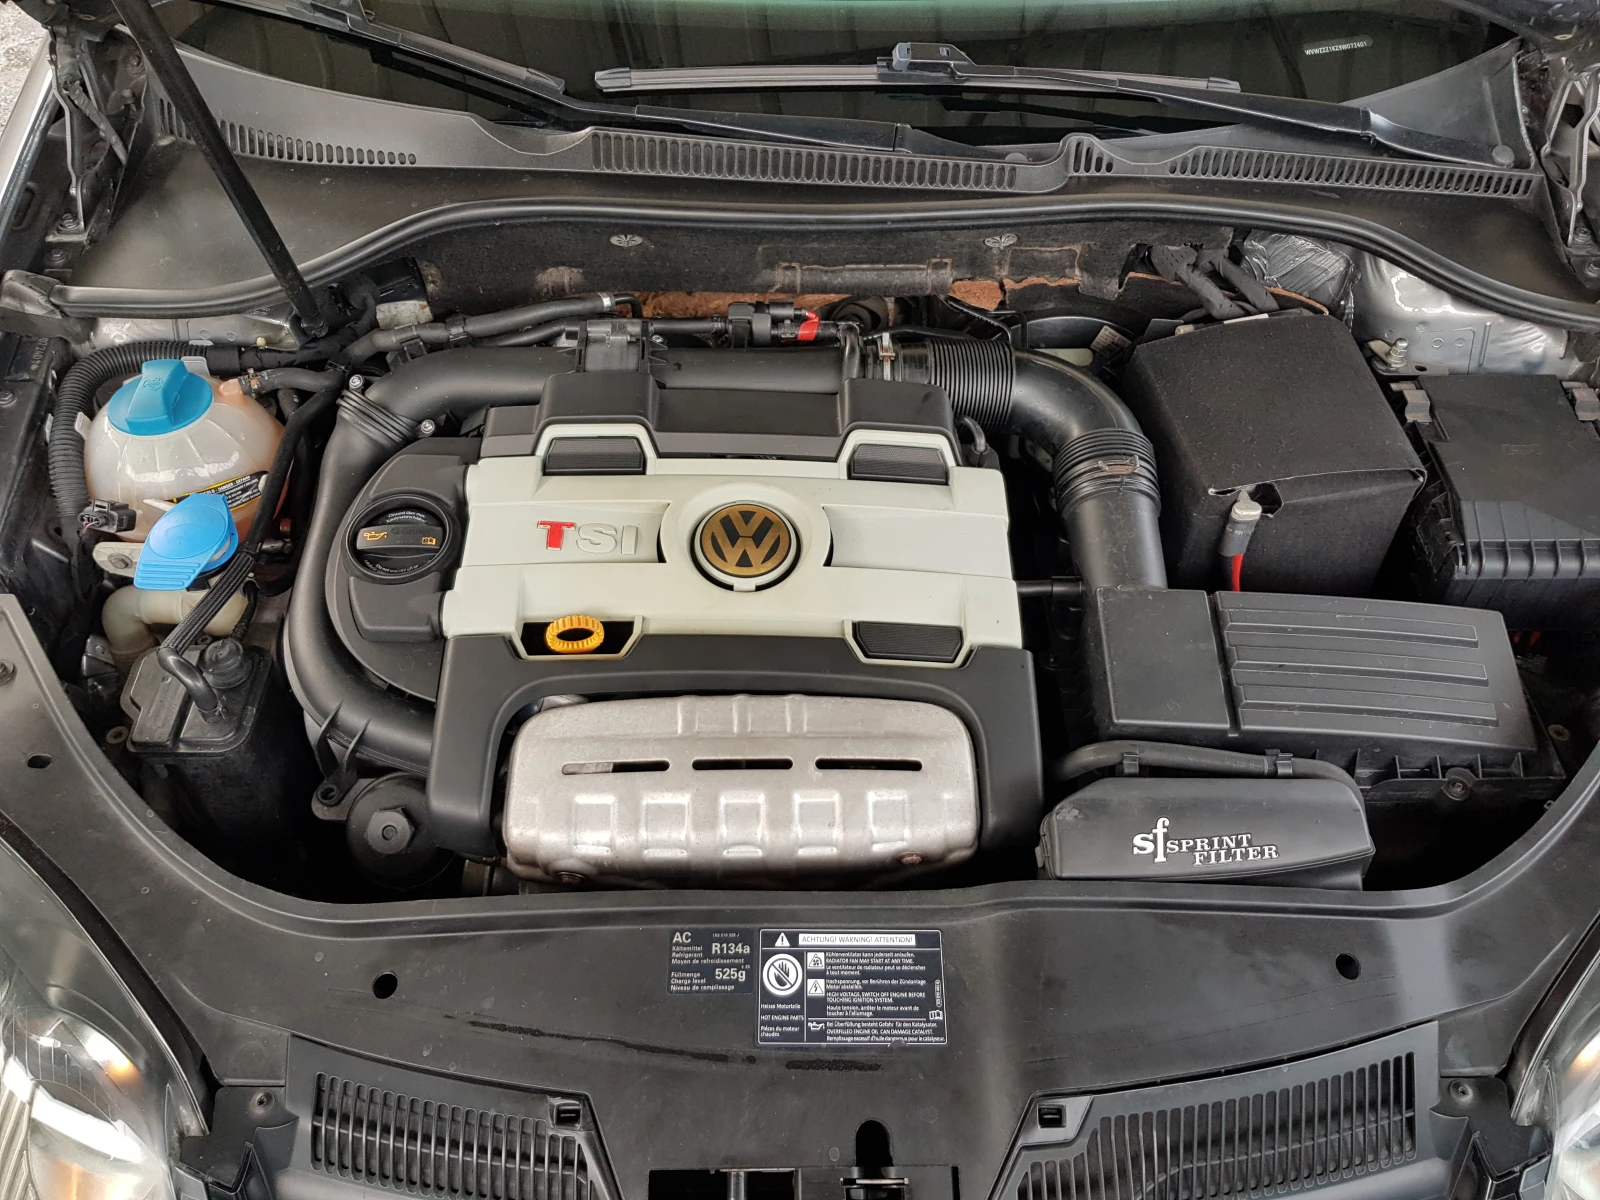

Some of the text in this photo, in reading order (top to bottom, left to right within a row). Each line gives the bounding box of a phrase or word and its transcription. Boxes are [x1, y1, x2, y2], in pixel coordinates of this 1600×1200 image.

[537, 520, 638, 555] TSI
[1166, 833, 1251, 853] SPRINT
[1193, 845, 1279, 867] FILTER
[672, 932, 692, 943] AC
[712, 943, 750, 954] R134a
[715, 968, 746, 981] 525g
